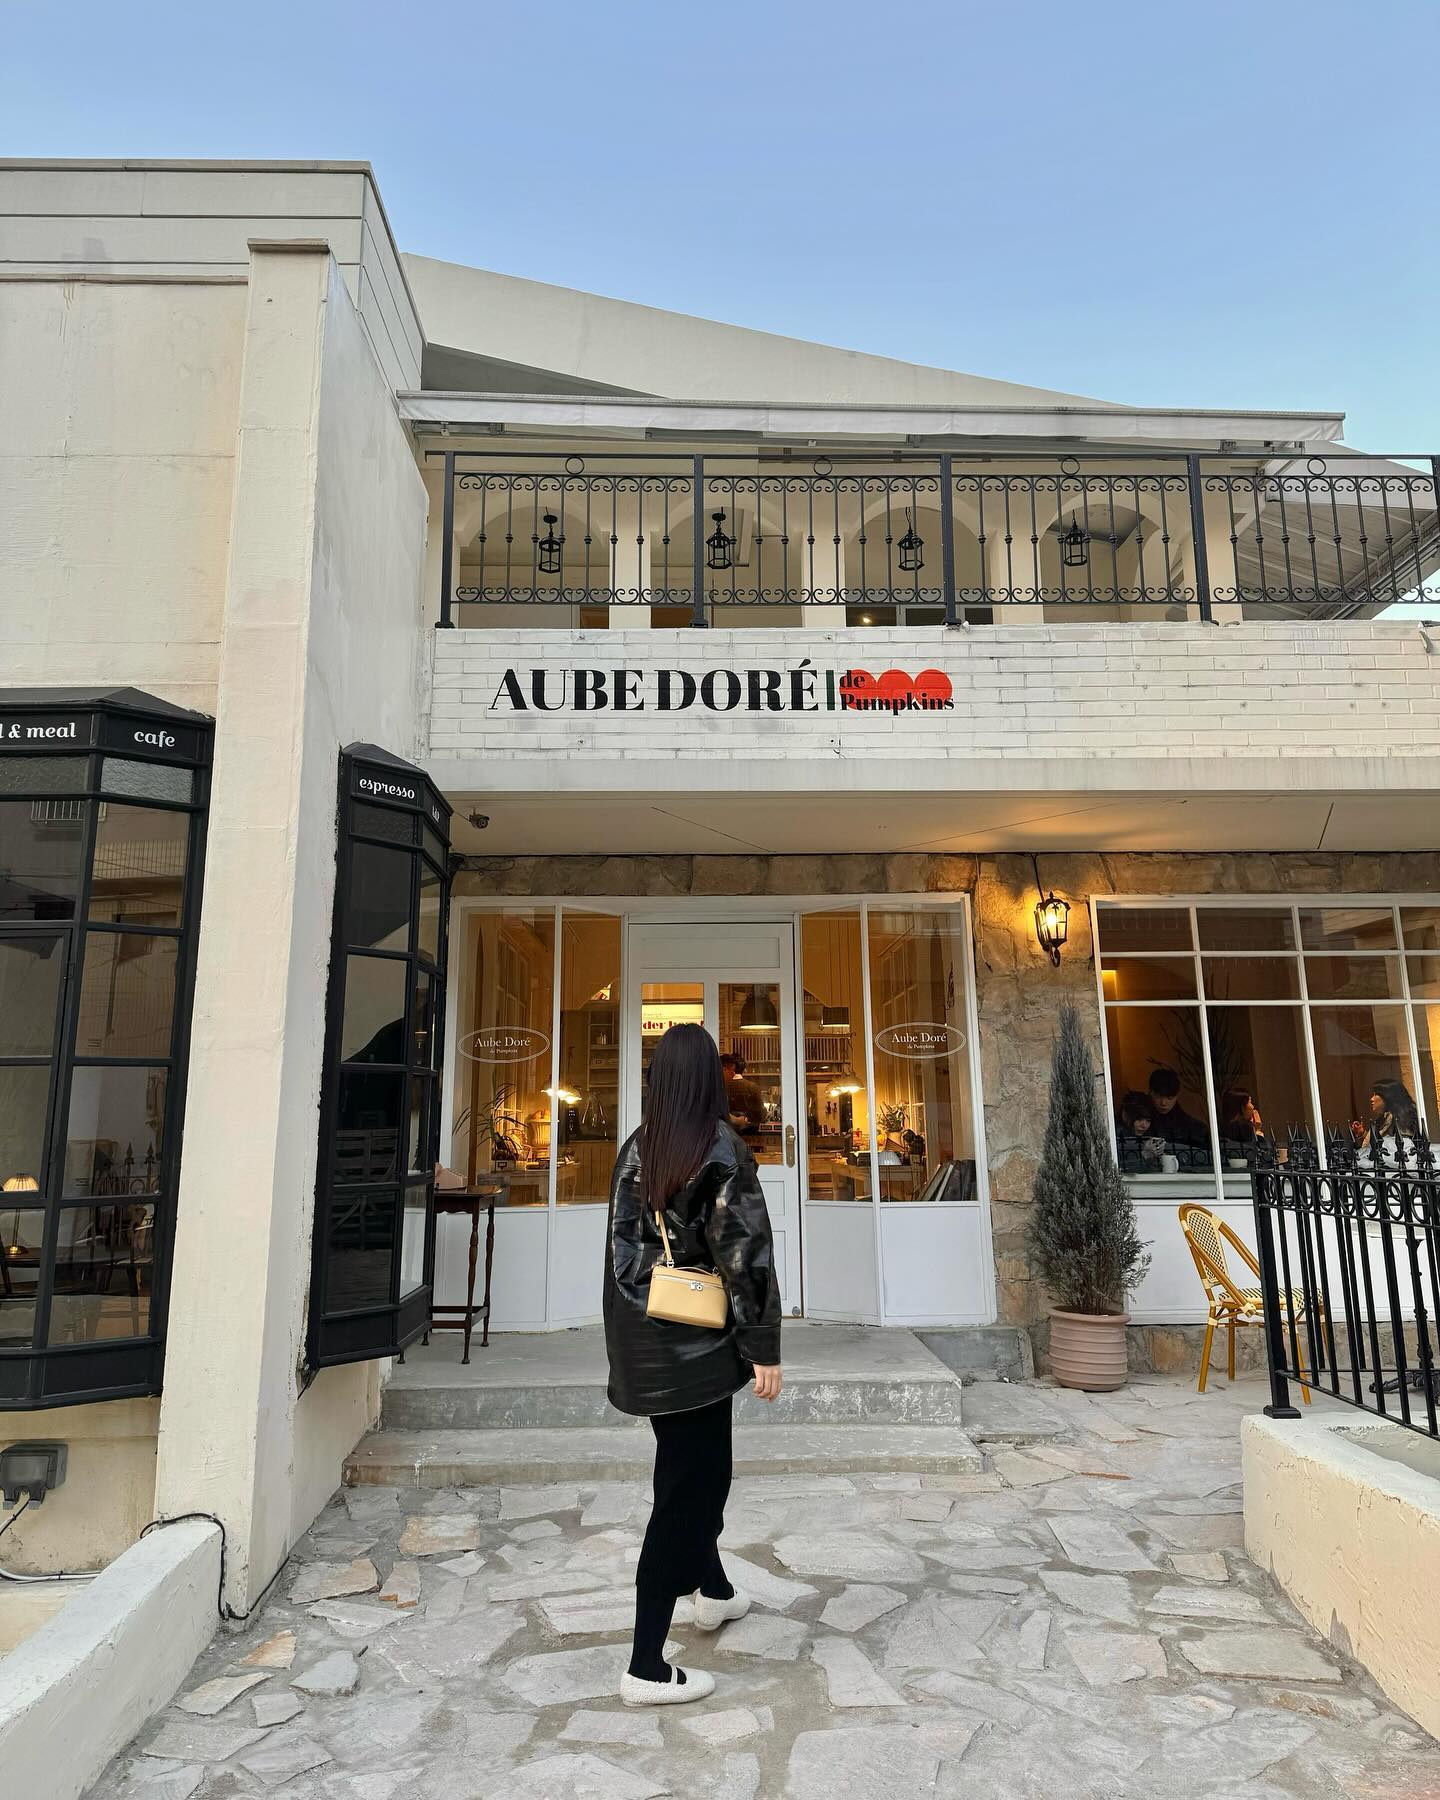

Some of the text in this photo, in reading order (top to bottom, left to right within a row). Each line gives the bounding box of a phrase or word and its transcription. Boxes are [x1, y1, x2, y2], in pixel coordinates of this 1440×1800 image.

[488, 658, 819, 711] AUBE DORÉ
[839, 669, 866, 689] de
[840, 692, 955, 716] Pumpkins
[8, 723, 22, 739] &
[26, 722, 77, 738] meal
[133, 730, 176, 748] cafe
[359, 778, 415, 799] espresso
[474, 1035, 531, 1048] Aube Doré
[892, 1032, 947, 1043] Aube Doré
